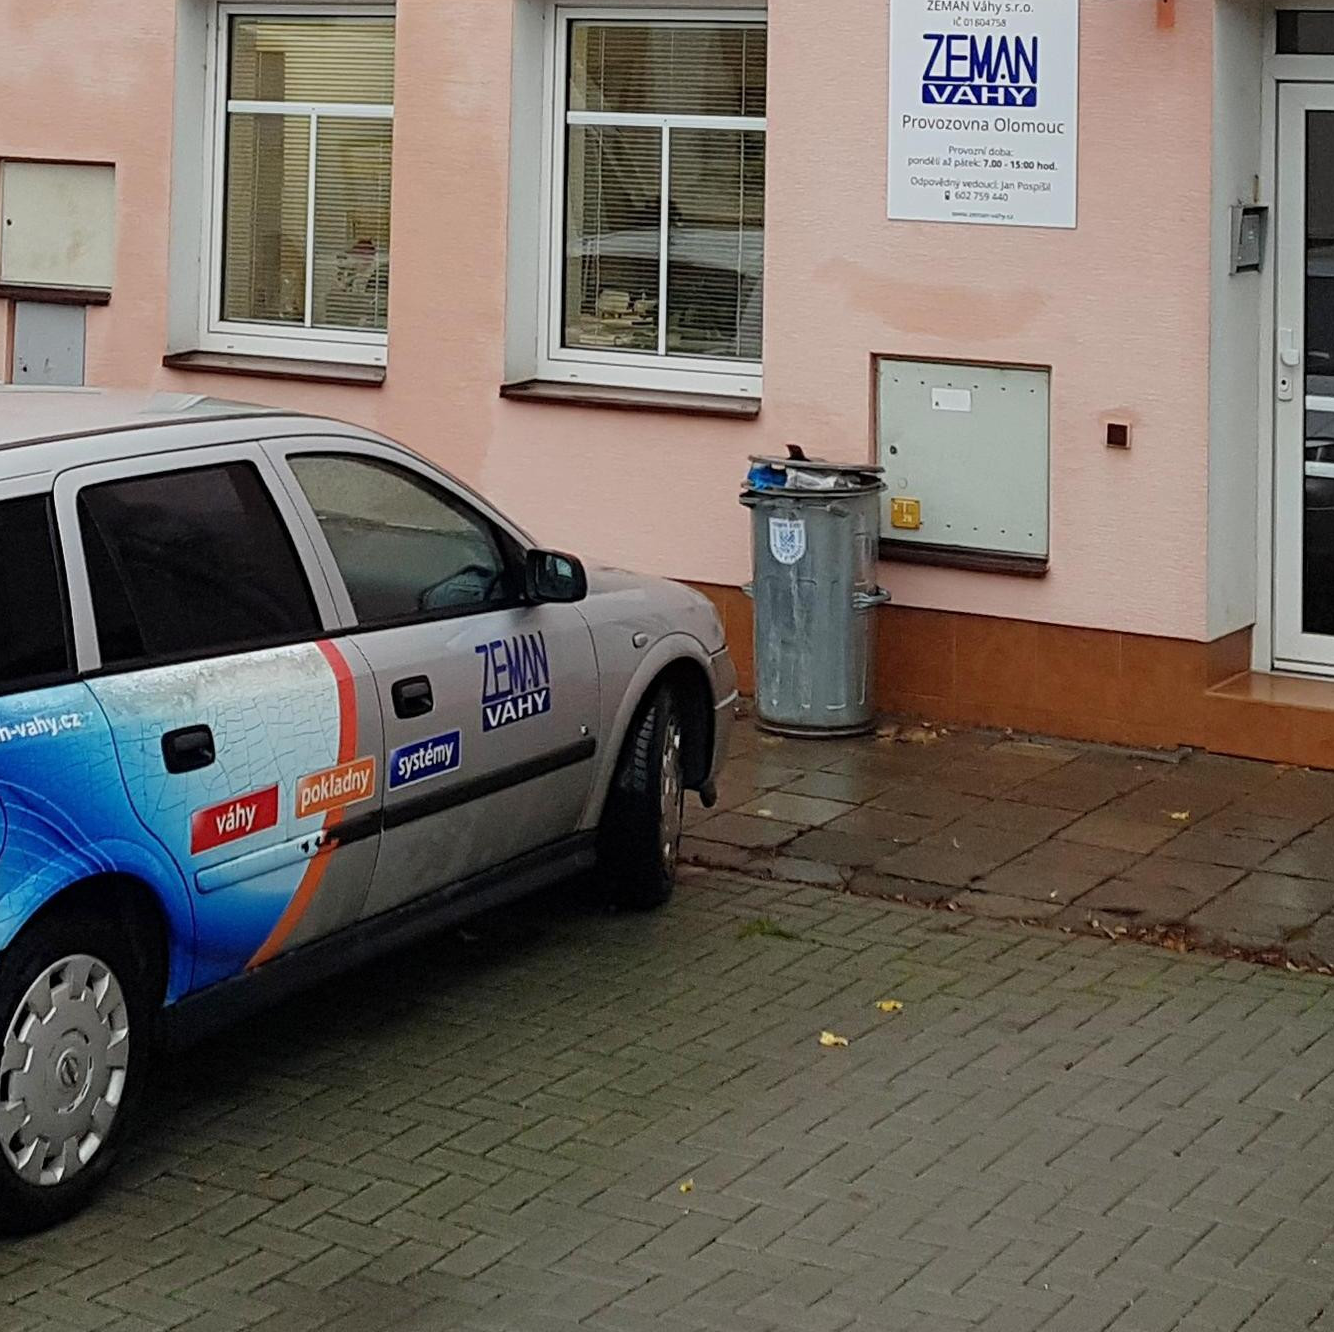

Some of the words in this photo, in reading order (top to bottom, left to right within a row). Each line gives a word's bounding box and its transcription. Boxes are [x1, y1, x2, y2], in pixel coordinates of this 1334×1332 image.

[926, 0, 969, 12] ZEMAN
[973, 0, 1002, 15] Váhy
[1005, 3, 1034, 13] s.r.o.
[923, 33, 1038, 84] ZEMAN
[928, 81, 1031, 105] VÁHY
[902, 114, 989, 131] Provozovna
[994, 118, 1065, 134] Olomouc
[1037, 161, 1058, 171] hod.
[475, 630, 550, 705] ZEMAN
[486, 689, 547, 727] VÁHY
[398, 740, 455, 780] systémy
[300, 766, 370, 812] pokladny
[216, 802, 257, 836] váhy
